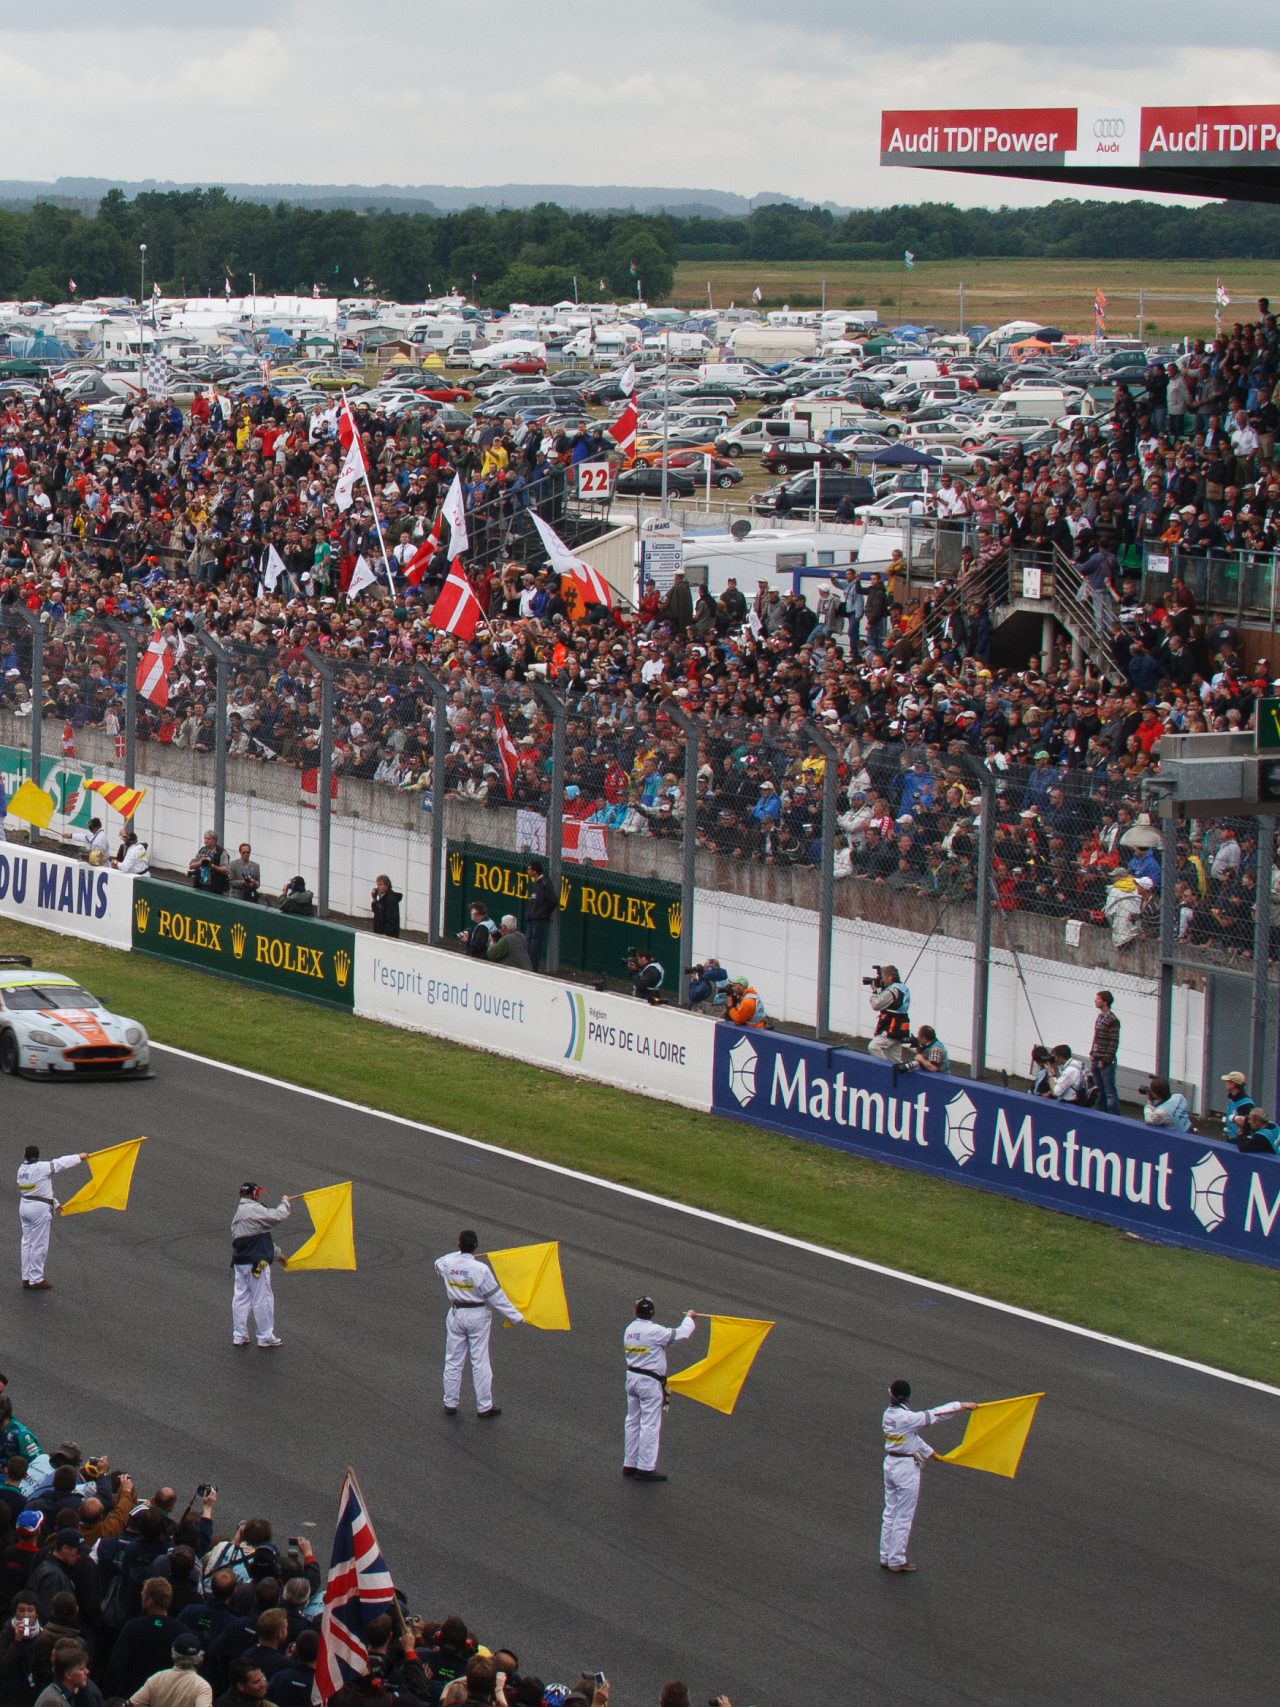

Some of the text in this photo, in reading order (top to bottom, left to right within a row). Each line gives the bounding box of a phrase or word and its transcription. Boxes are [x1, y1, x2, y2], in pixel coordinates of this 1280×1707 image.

[888, 127, 939, 153] Audi
[983, 127, 1059, 153] Power
[1096, 141, 1120, 153] Audi
[1148, 124, 1208, 152] Audi
[581, 469, 608, 492] 22
[37, 862, 109, 920] MANS
[474, 862, 532, 899] ROLE
[580, 886, 656, 929] ROLEX
[158, 908, 222, 951] ROLEX
[255, 935, 324, 979] ROLEX
[372, 958, 525, 1024] l'esprit grand ouvert
[588, 1022, 686, 1066] PAYS DE LA LOIRE
[770, 1052, 928, 1147] Matmut
[991, 1108, 1172, 1211] Matmut
